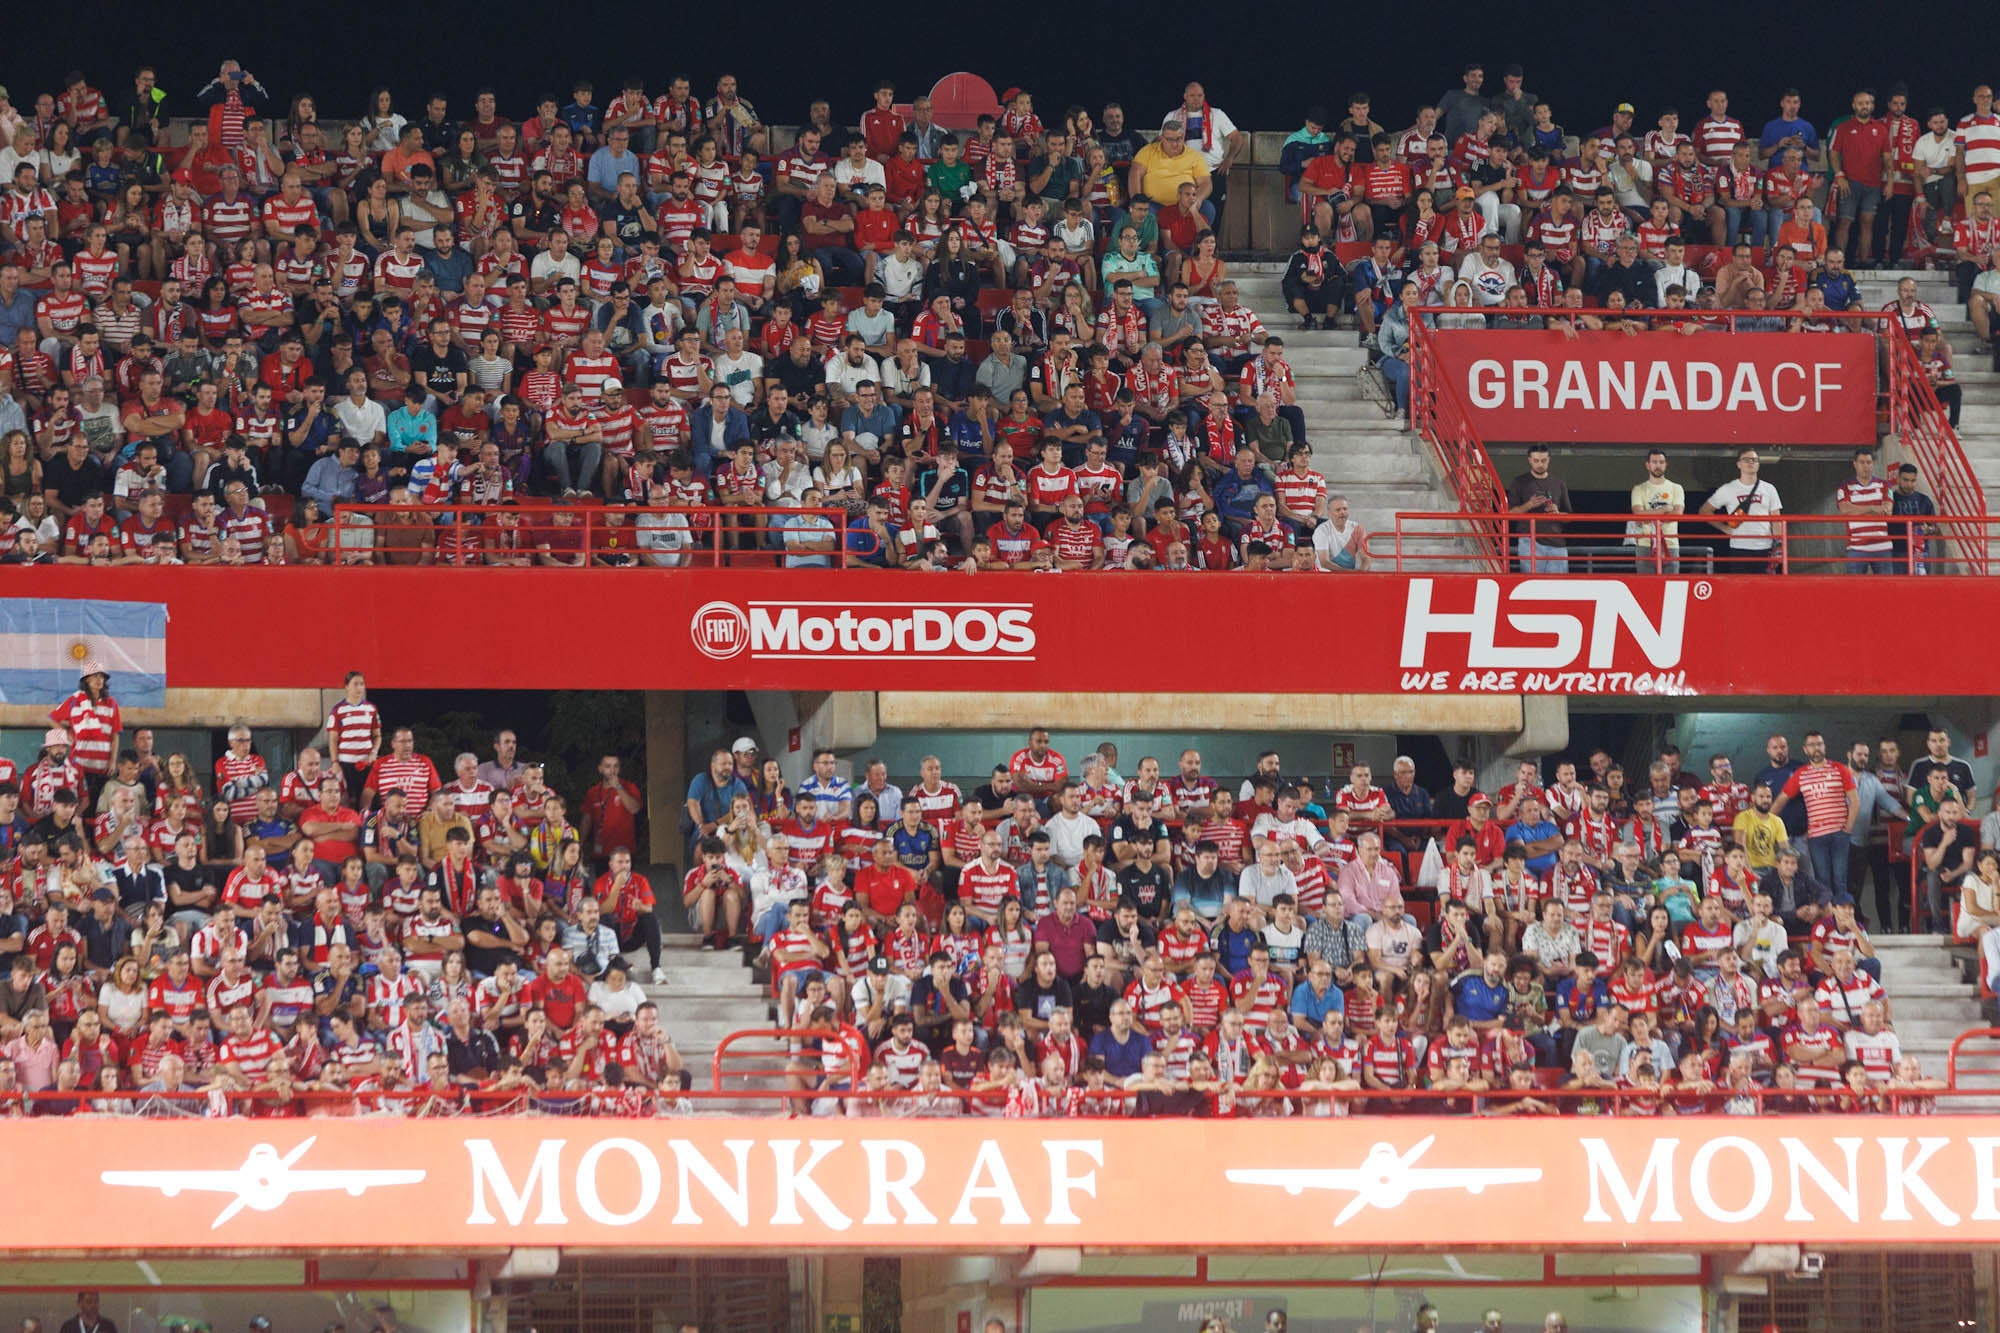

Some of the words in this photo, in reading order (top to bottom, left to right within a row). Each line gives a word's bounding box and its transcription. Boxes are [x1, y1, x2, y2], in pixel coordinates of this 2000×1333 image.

[1468, 359, 1842, 411] GRANADACF
[706, 619, 736, 643] FIAT
[750, 608, 1036, 653] MotorDOS
[1400, 578, 1689, 669] HSN
[1400, 670, 1450, 691] WE
[1459, 670, 1518, 692] ARE
[1521, 670, 1686, 694] NUTRITION!
[463, 1137, 1104, 1231] MONKRAF
